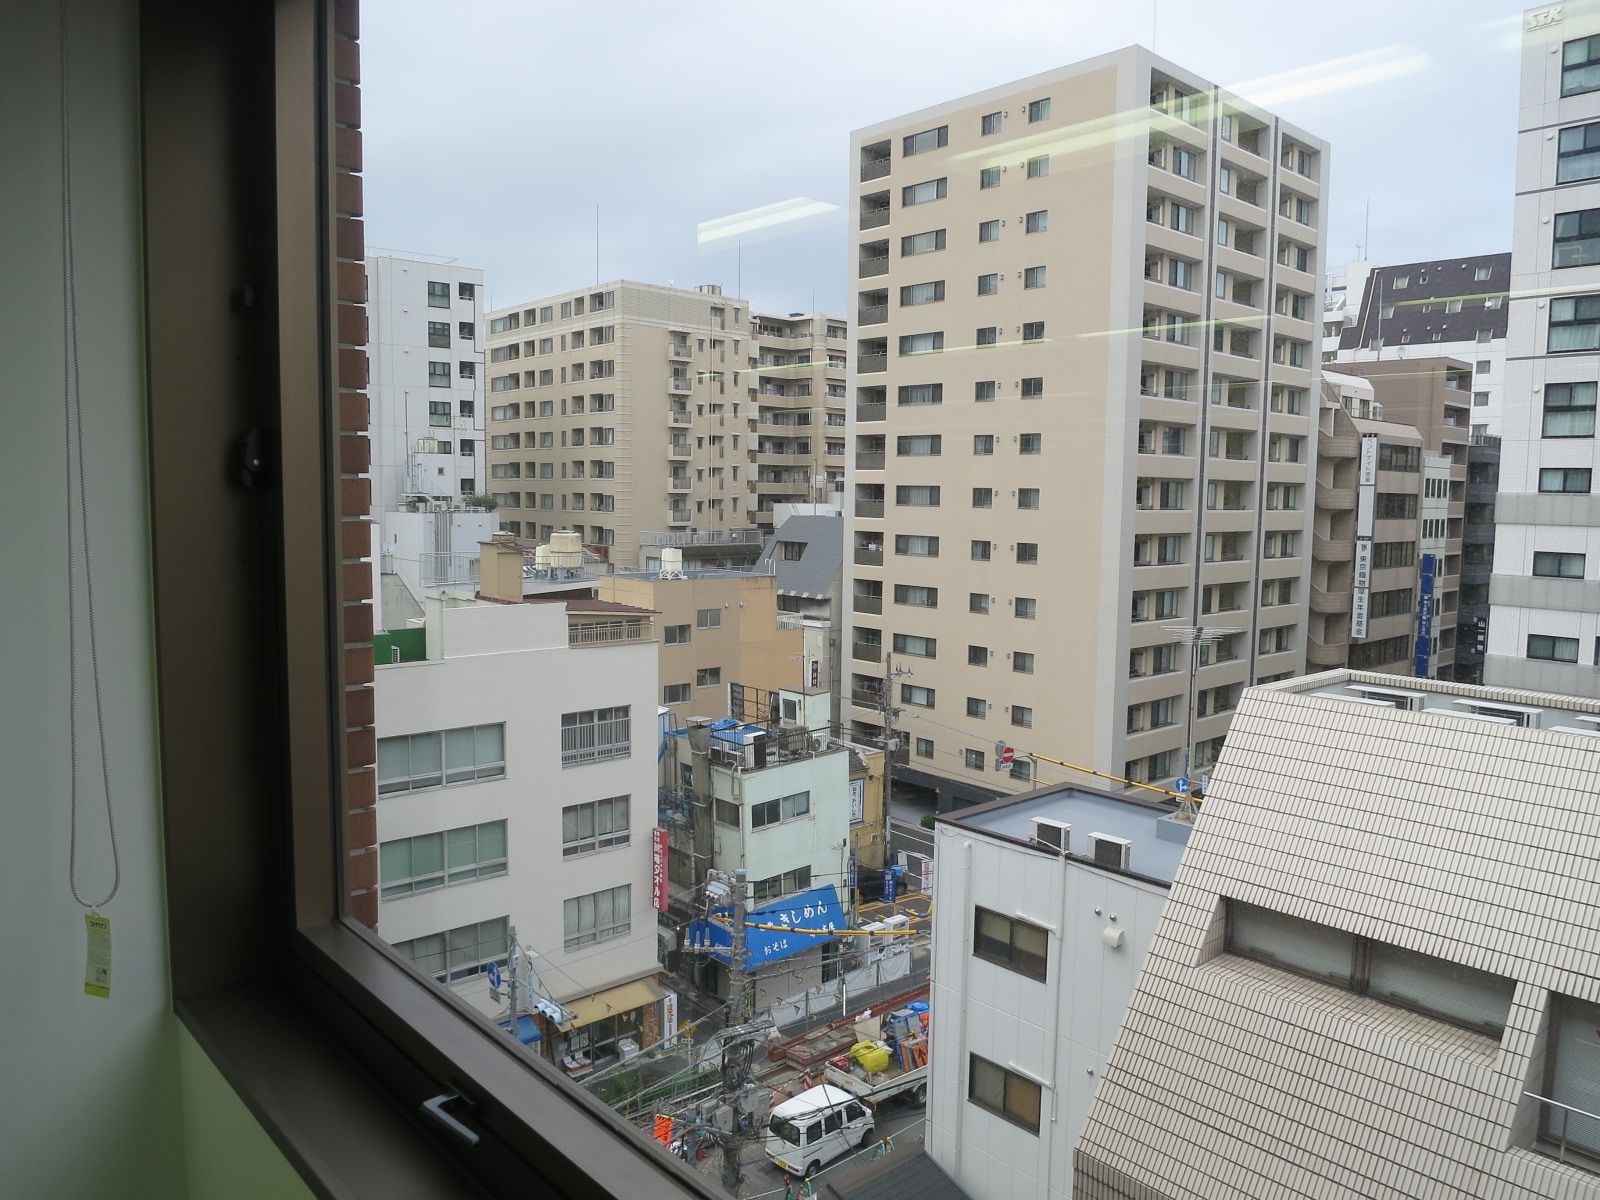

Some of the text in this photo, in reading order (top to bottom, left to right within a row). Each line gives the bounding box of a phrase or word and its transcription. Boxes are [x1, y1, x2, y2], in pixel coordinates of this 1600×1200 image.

[779, 900, 828, 928] きしめん
[763, 938, 788, 956] おそば
